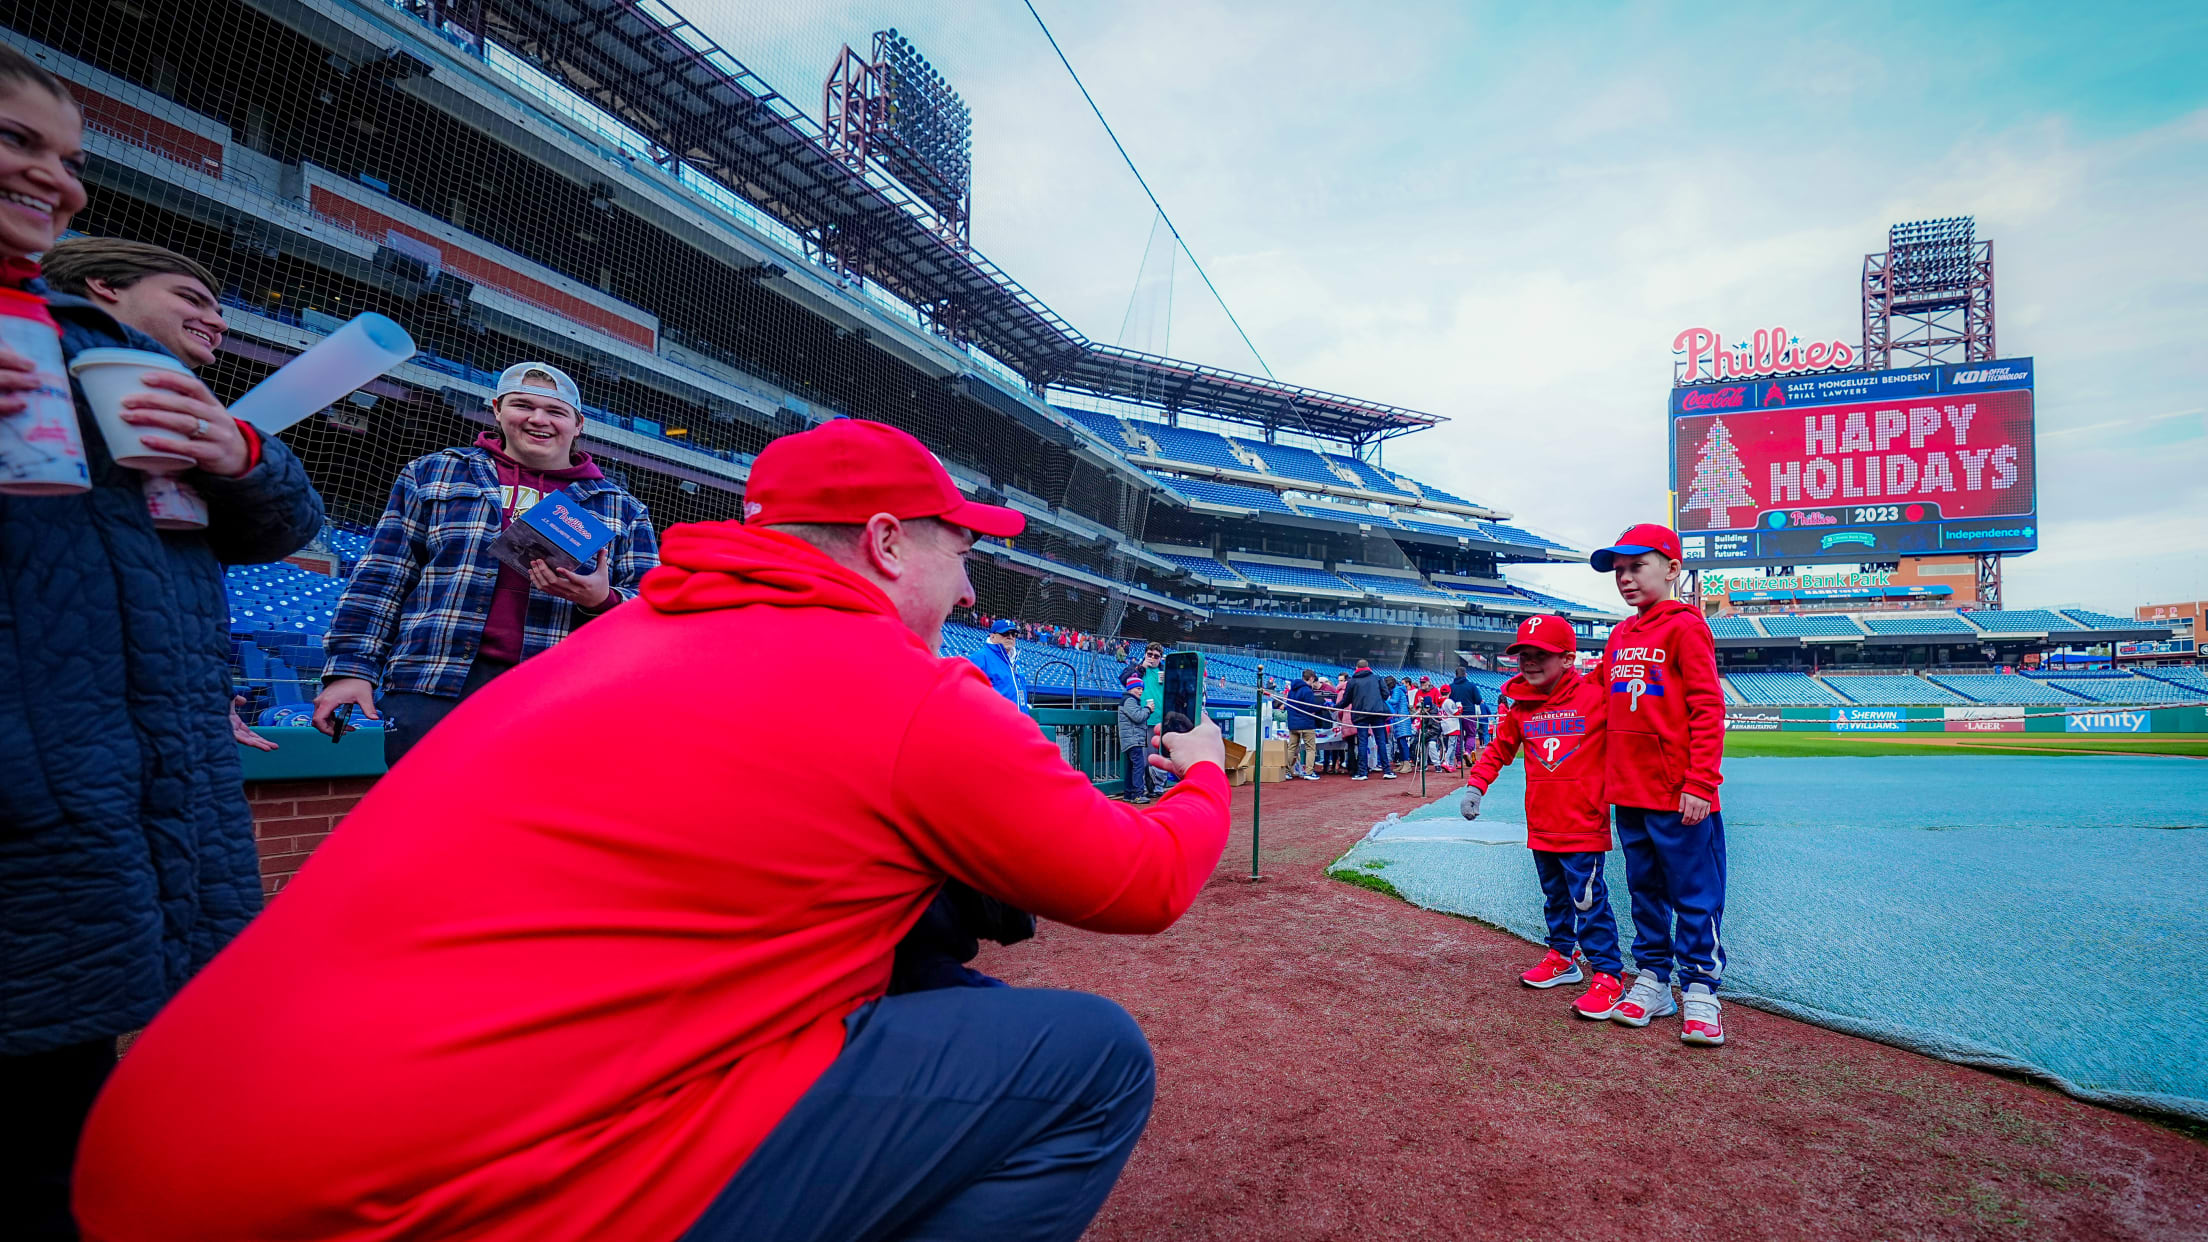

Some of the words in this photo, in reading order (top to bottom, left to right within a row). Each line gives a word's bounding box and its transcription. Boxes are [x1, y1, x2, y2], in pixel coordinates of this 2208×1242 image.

[1673, 326, 1855, 381] Phillies
[1987, 371, 2028, 382] TECHNOLOGY
[1988, 367, 2010, 375] OFFICE
[1788, 382, 1814, 392] SALTZ
[1818, 377, 1878, 390] MONGELUZZI
[1882, 372, 1931, 384] BENDESKY
[1683, 387, 1747, 411] Coca-Cola
[1788, 392, 1815, 400] TRIAL
[1823, 387, 1868, 398] LAWYERS
[1805, 403, 1976, 455] HAPPY
[1770, 444, 2018, 504] HOLIDAYS
[552, 504, 592, 540] Phillies
[1790, 511, 1838, 526] Phillies
[1854, 506, 1899, 523] 2023
[1714, 534, 1748, 543] Building
[1946, 527, 2020, 541] Independence
[1714, 542, 1737, 550] brave
[1729, 576, 1798, 591] Citizens
[1802, 571, 1846, 588] Bank
[1850, 569, 1890, 587] Park
[1528, 617, 1542, 634] P
[1616, 647, 1666, 663] WORLD
[1626, 678, 1647, 712] P
[1531, 711, 1575, 721] PHILADELPHIA
[1851, 709, 1897, 719] SHERWIN
[2070, 711, 2145, 731] xfinity
[1523, 719, 1585, 737] PHILLIES
[1968, 722, 2000, 730] LAGER
[1543, 737, 1560, 762] P
